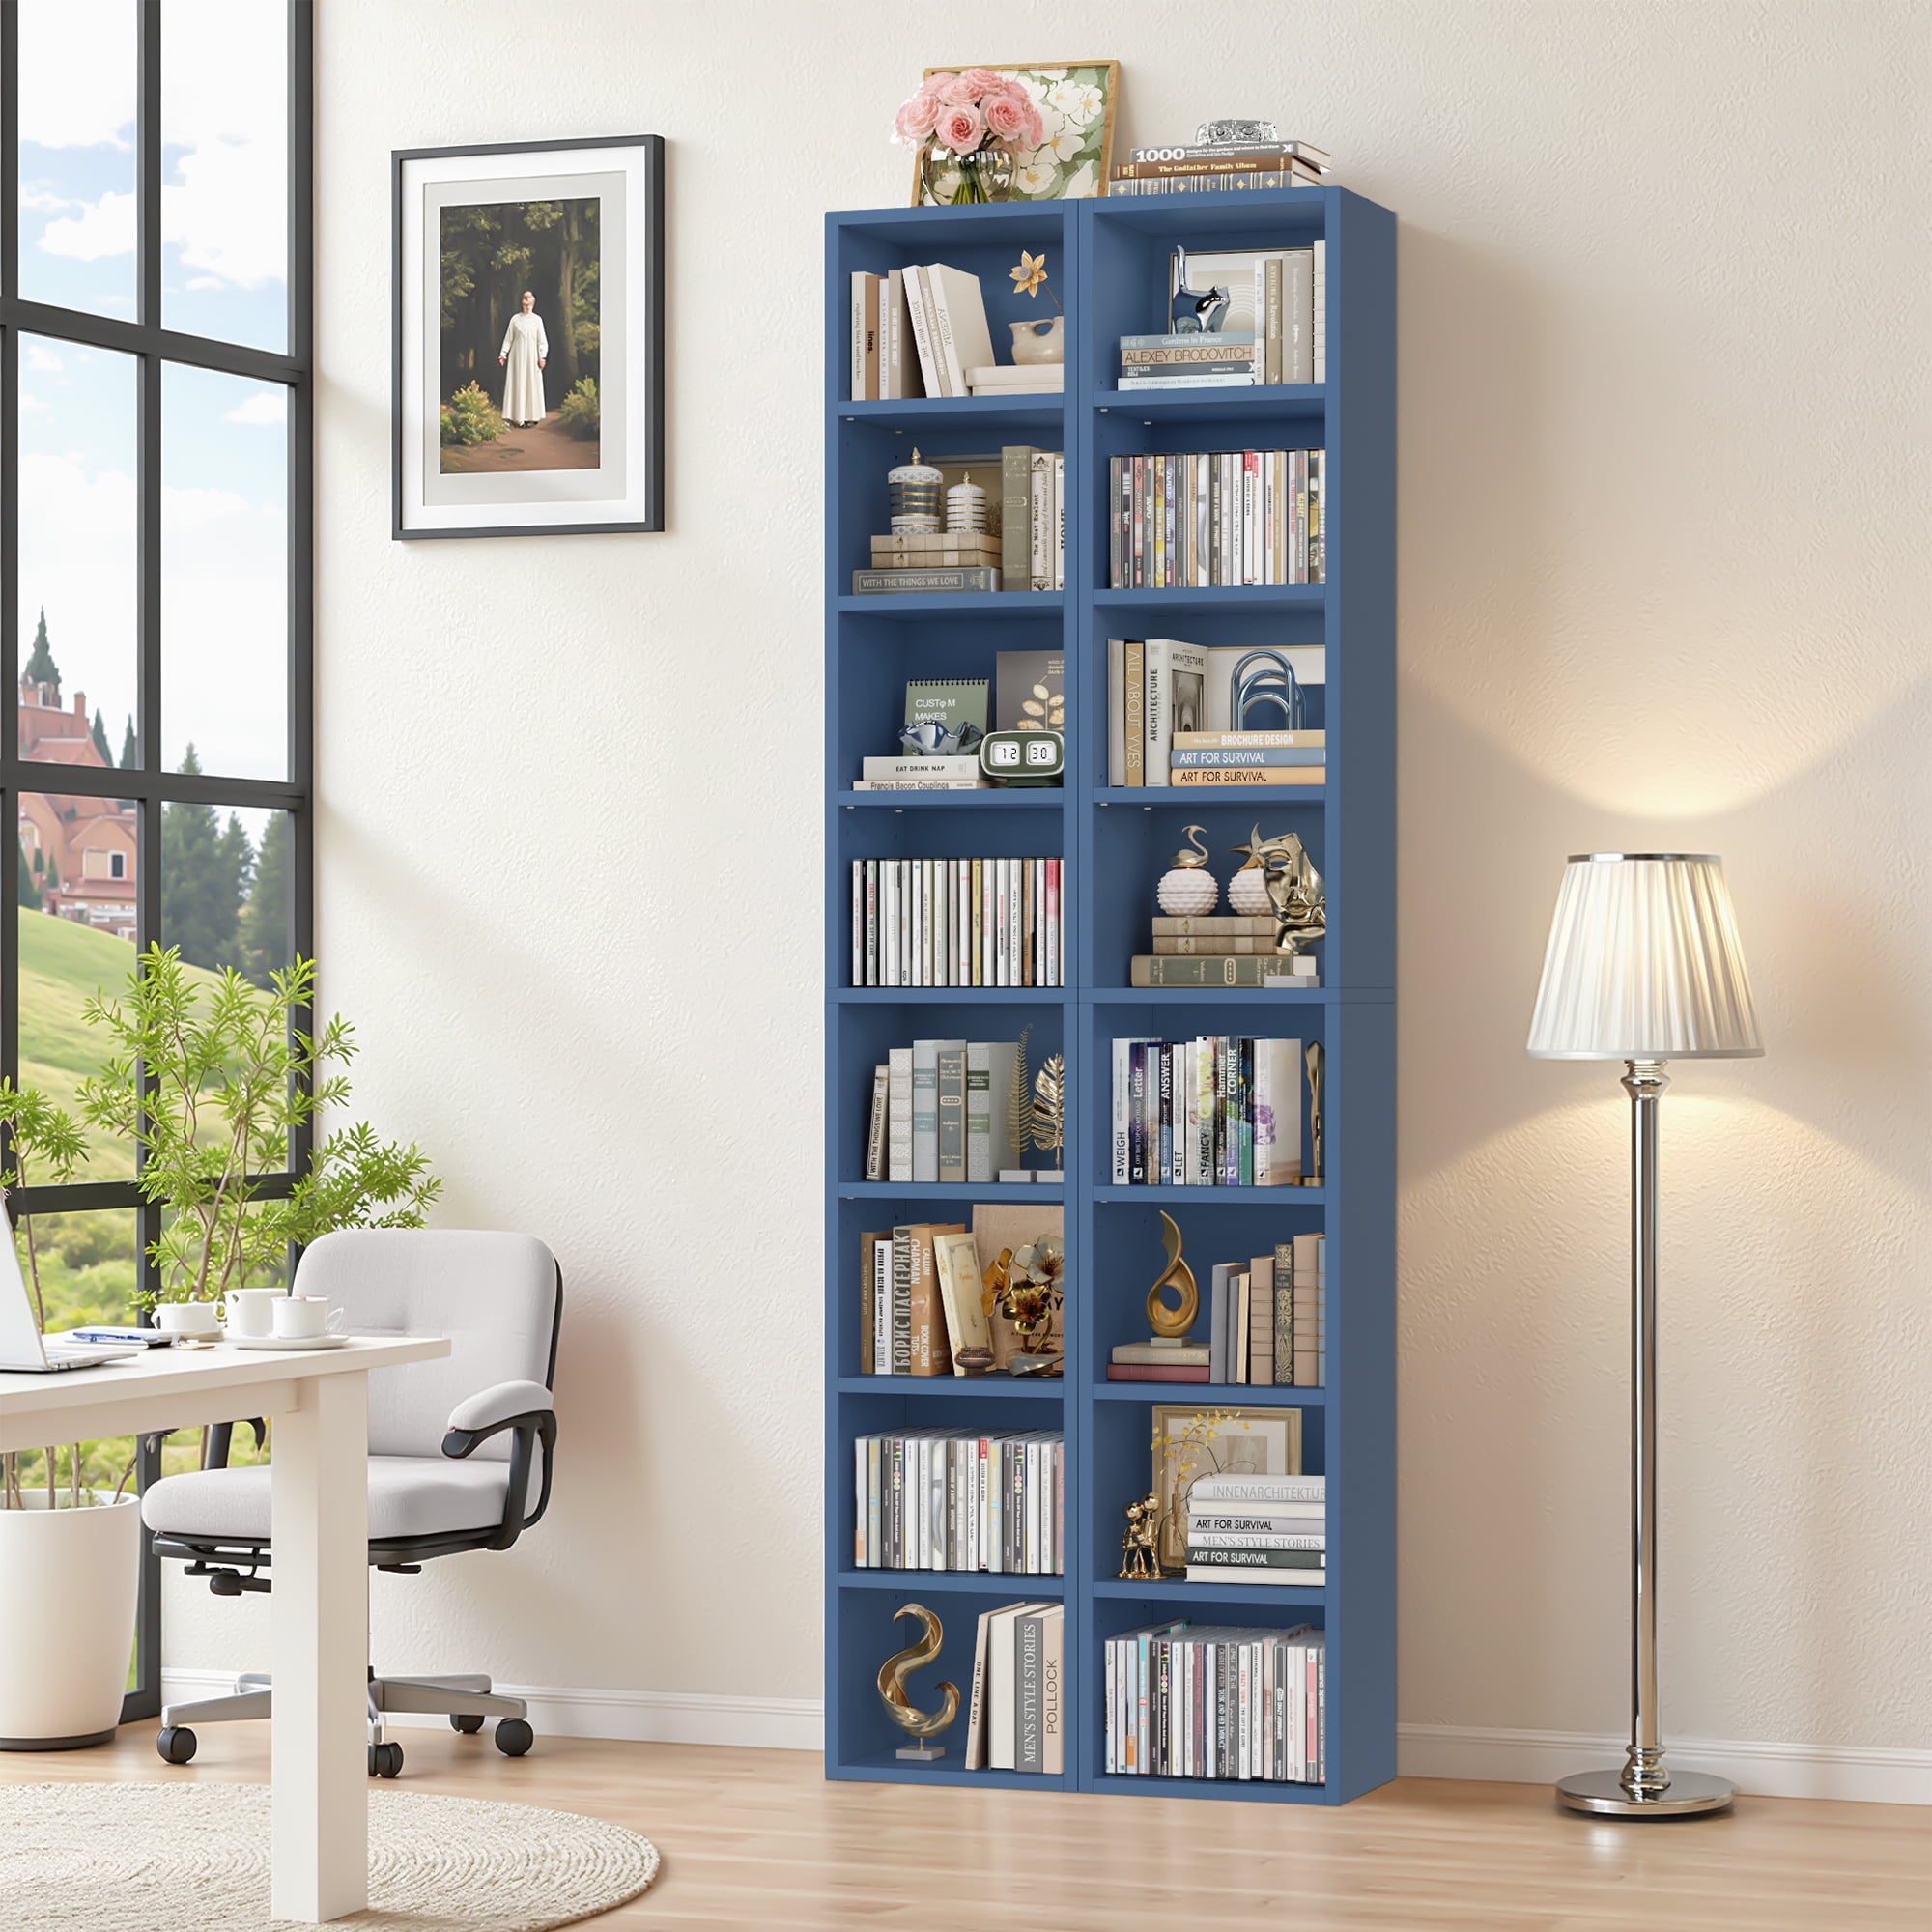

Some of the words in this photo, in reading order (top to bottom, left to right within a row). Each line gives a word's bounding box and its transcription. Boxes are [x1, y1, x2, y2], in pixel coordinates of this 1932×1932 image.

[1136, 148, 1185, 163] 1000
[1173, 163, 1208, 172] Godfather
[1210, 162, 1234, 171] Family
[1124, 350, 1171, 364] ALEXEY
[1174, 347, 1251, 362] BRODOVITCH
[862, 579, 882, 587] WITH
[883, 577, 897, 587] THE
[899, 576, 926, 587] THINGS
[927, 575, 940, 585] WE
[940, 574, 958, 585] LOVE
[1128, 650, 1141, 675] ALL
[1172, 653, 1204, 667] ARCHITECTURE
[1128, 680, 1141, 728] ABOUT
[915, 712, 947, 722] MAKES
[1128, 734, 1141, 769] YVES
[1221, 734, 1264, 747] BROCHURE
[1264, 733, 1293, 745] DESIGN
[1002, 747, 1017, 761] 12
[1033, 747, 1048, 760] 30
[1179, 753, 1198, 764] ART
[1200, 752, 1220, 764] FOR
[1222, 752, 1265, 763] SURVIVAL
[870, 781, 894, 791] Francis
[895, 781, 916, 790] Bacon
[917, 781, 950, 790] Couplings
[1180, 772, 1199, 782] ART
[1202, 771, 1221, 782] FOR
[1223, 771, 1266, 781] SURVIVAL
[1133, 1067, 1142, 1097] Letter
[1161, 1053, 1170, 1099] ANSWER
[1198, 1052, 1212, 1119] GATHER
[1217, 1055, 1226, 1098] Hammer
[875, 1114, 881, 1123] WE
[1117, 1132, 1125, 1167] WEIGH
[1201, 1133, 1209, 1167] FANCY
[911, 1238, 920, 1284] CHAPMAN
[895, 1235, 910, 1317] ПАСТЕРНАК
[895, 1321, 910, 1366] БОРИС
[1196, 1519, 1211, 1529] ART
[1214, 1519, 1232, 1529] FOR
[1234, 1520, 1272, 1530] SURVIVAL
[1203, 1536, 1236, 1547] MEN'S
[1237, 1536, 1272, 1548] STYLE
[1274, 1538, 1321, 1549] STORIES
[1192, 1551, 1208, 1562] ART
[1210, 1551, 1228, 1563] FOR
[1230, 1552, 1267, 1564] SURVIVAL
[1024, 1624, 1036, 1681] STORIES
[1024, 1681, 1036, 1720] STYLE
[1046, 1659, 1057, 1734] POLLOCK
[1024, 1723, 1036, 1762] MEN'S
